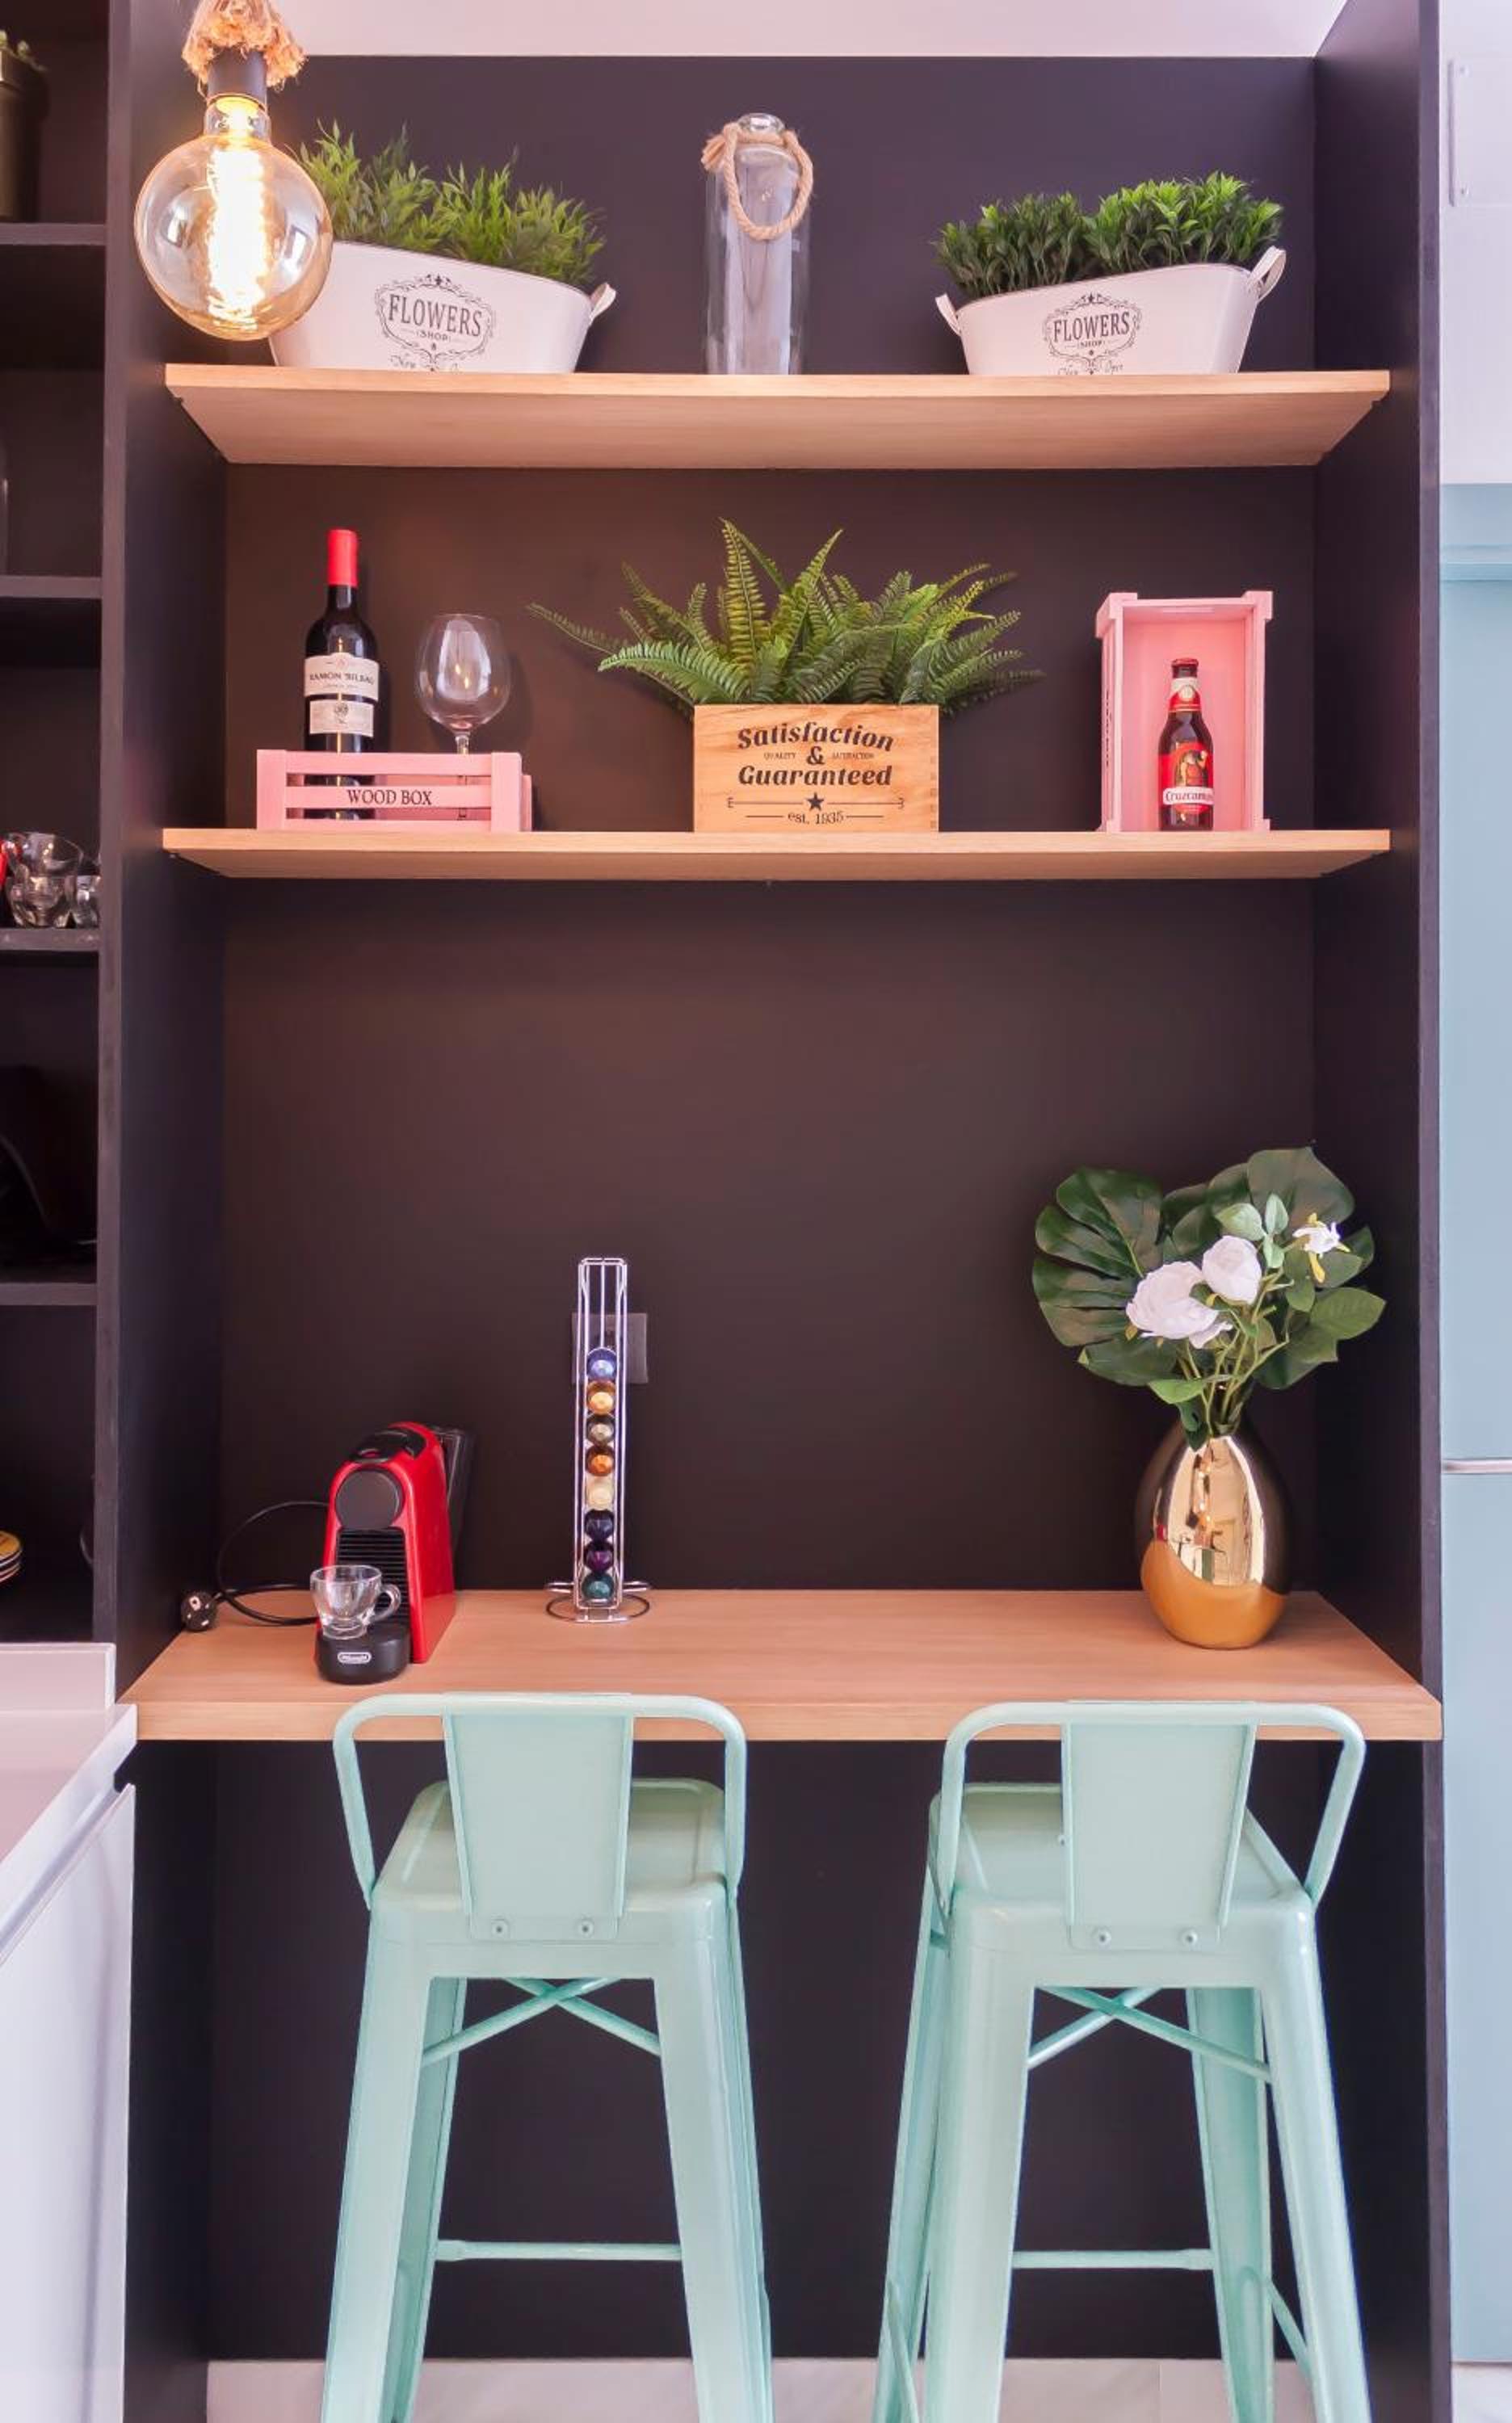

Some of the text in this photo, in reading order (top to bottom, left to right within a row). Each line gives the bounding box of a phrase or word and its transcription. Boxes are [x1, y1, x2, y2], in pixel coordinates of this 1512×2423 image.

[388, 294, 482, 337] FLOWERS
[419, 330, 448, 341] SHOP
[1053, 311, 1130, 342] FLOWERS
[737, 722, 894, 752] Satisfaction
[807, 745, 825, 765] &
[738, 766, 892, 786] Guaranteed
[347, 789, 432, 806] WOOD BOX
[815, 811, 845, 825] 1935
